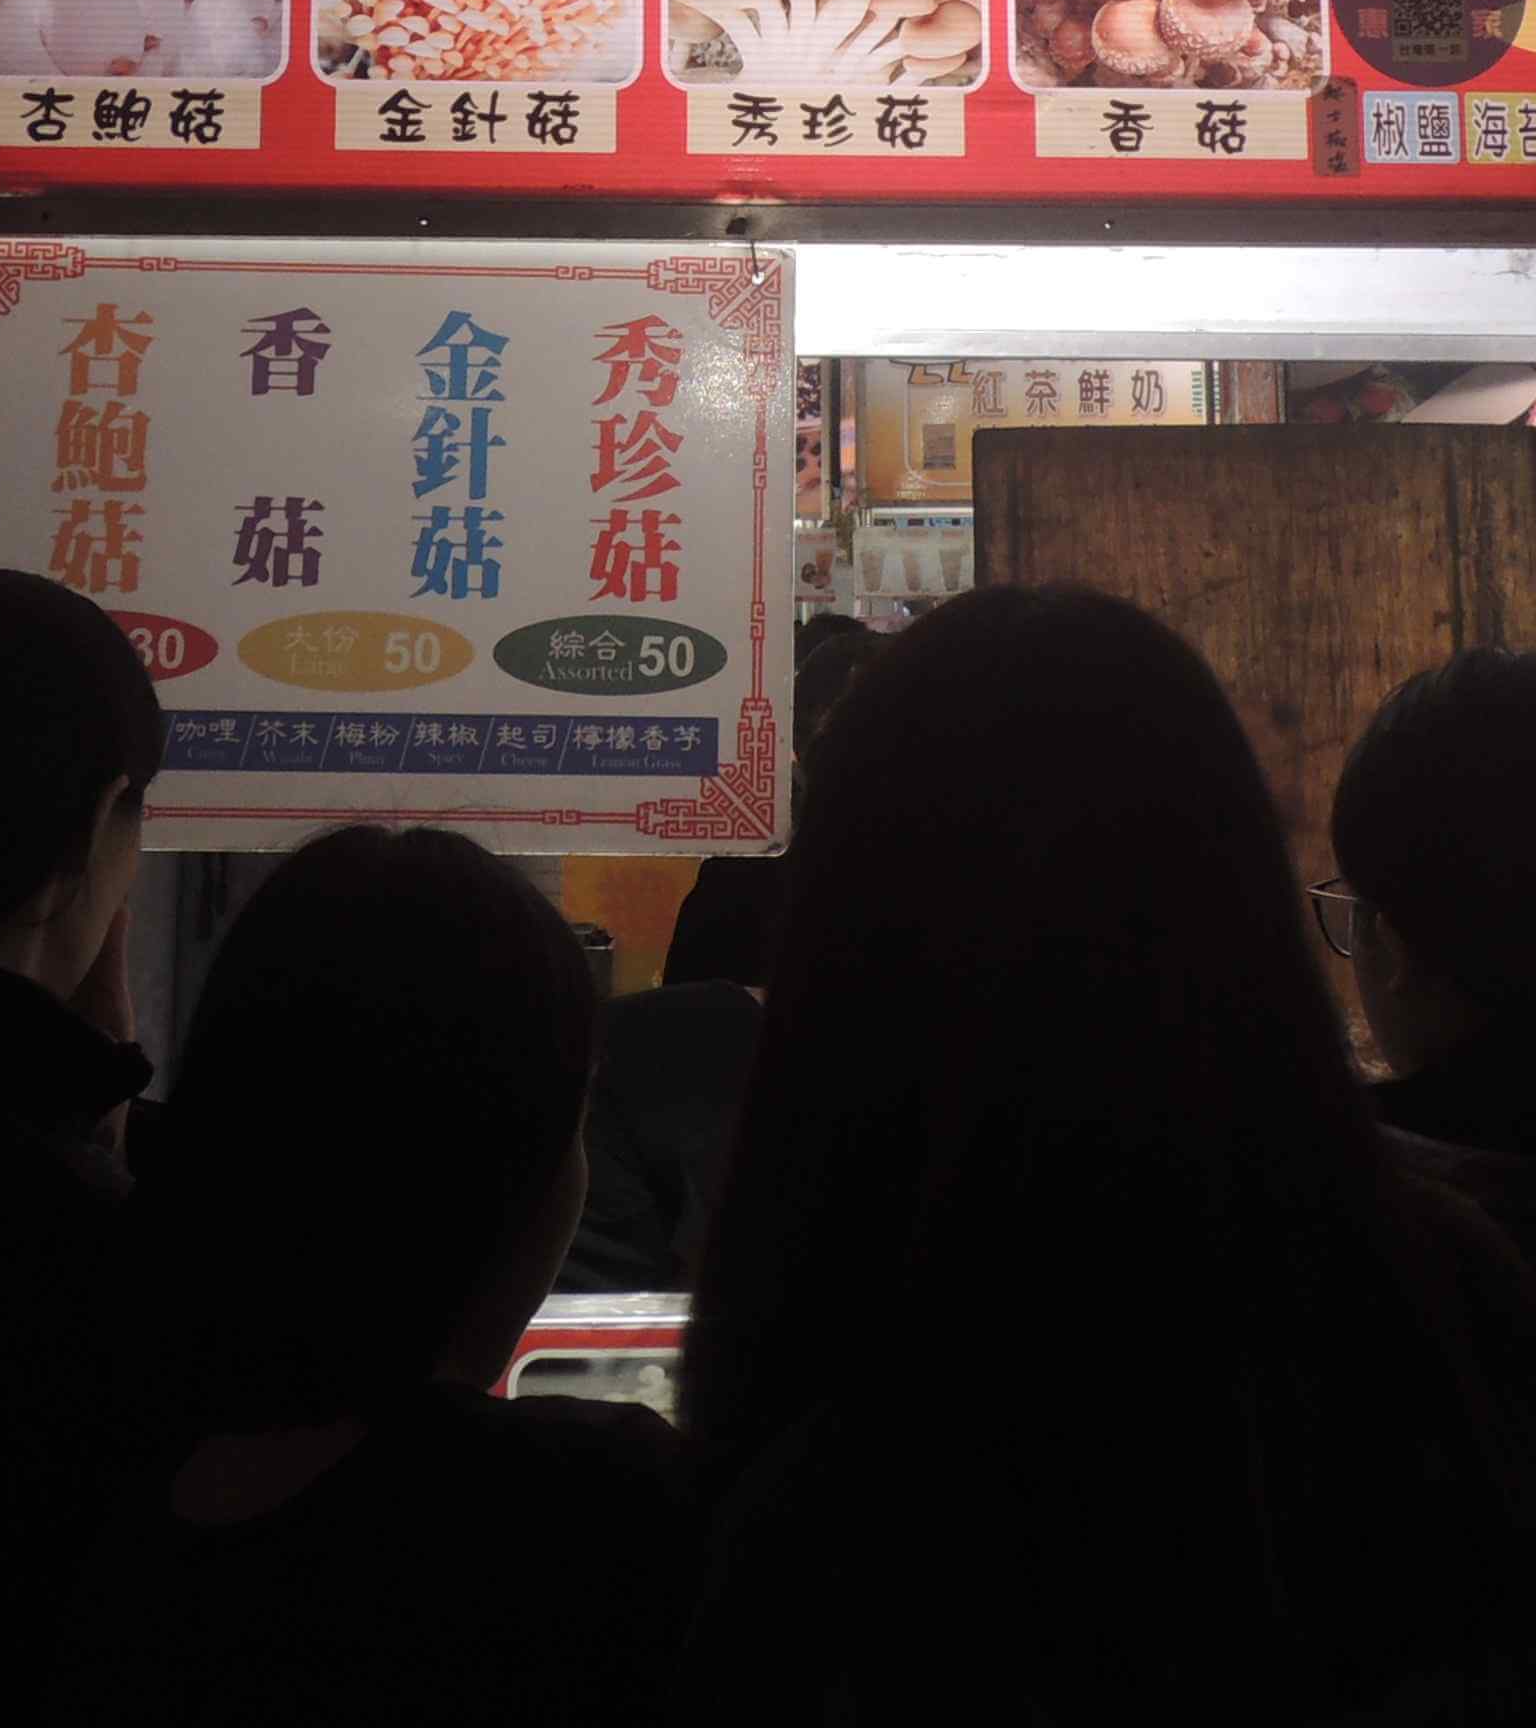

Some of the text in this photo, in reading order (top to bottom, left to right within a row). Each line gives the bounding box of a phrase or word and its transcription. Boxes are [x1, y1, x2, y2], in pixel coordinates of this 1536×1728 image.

[19, 89, 224, 144] 杏鮑菇
[377, 90, 579, 144] 金針菇
[728, 91, 928, 147] 秀珍菇
[1099, 97, 1248, 154] 香菇
[1372, 102, 1454, 158] 椒鹽
[974, 370, 1166, 417] 紅茶鮮奶
[46, 302, 152, 597] 杏鮑菇
[230, 306, 332, 590] 香菇
[409, 310, 509, 602] 金針菇
[589, 314, 684, 604] 秀珍菇
[382, 632, 440, 674] 50
[547, 628, 694, 677] 綜合 50
[176, 719, 241, 744] 咖哩
[260, 721, 319, 746] 芥末
[336, 722, 400, 747] 梅粉
[414, 722, 480, 748] 辣椒
[496, 722, 558, 750] 起司
